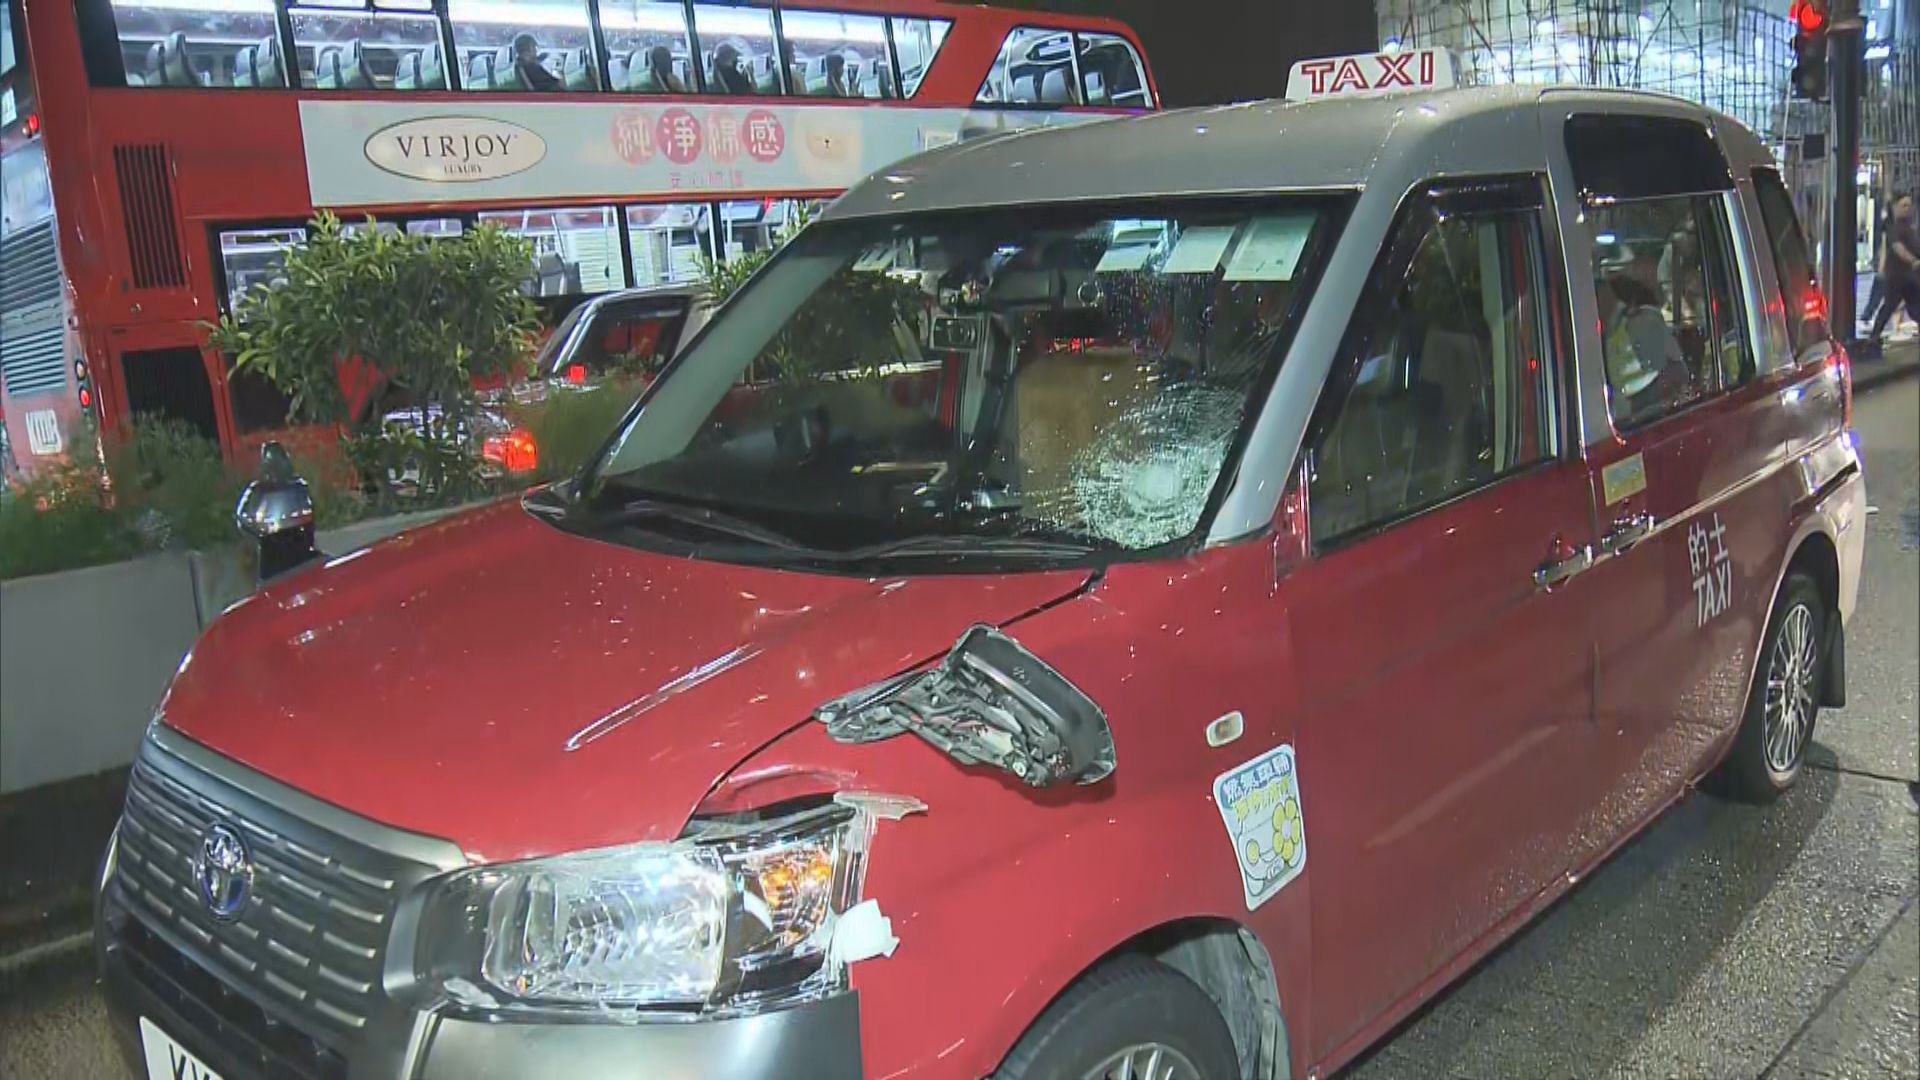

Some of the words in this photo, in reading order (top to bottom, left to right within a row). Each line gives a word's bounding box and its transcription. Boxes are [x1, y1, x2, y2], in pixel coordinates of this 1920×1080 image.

[1301, 51, 1434, 94] TAXI
[396, 133, 511, 163] VIRJOY
[1688, 512, 1729, 577] 的士
[1693, 560, 1732, 628] TAXI
